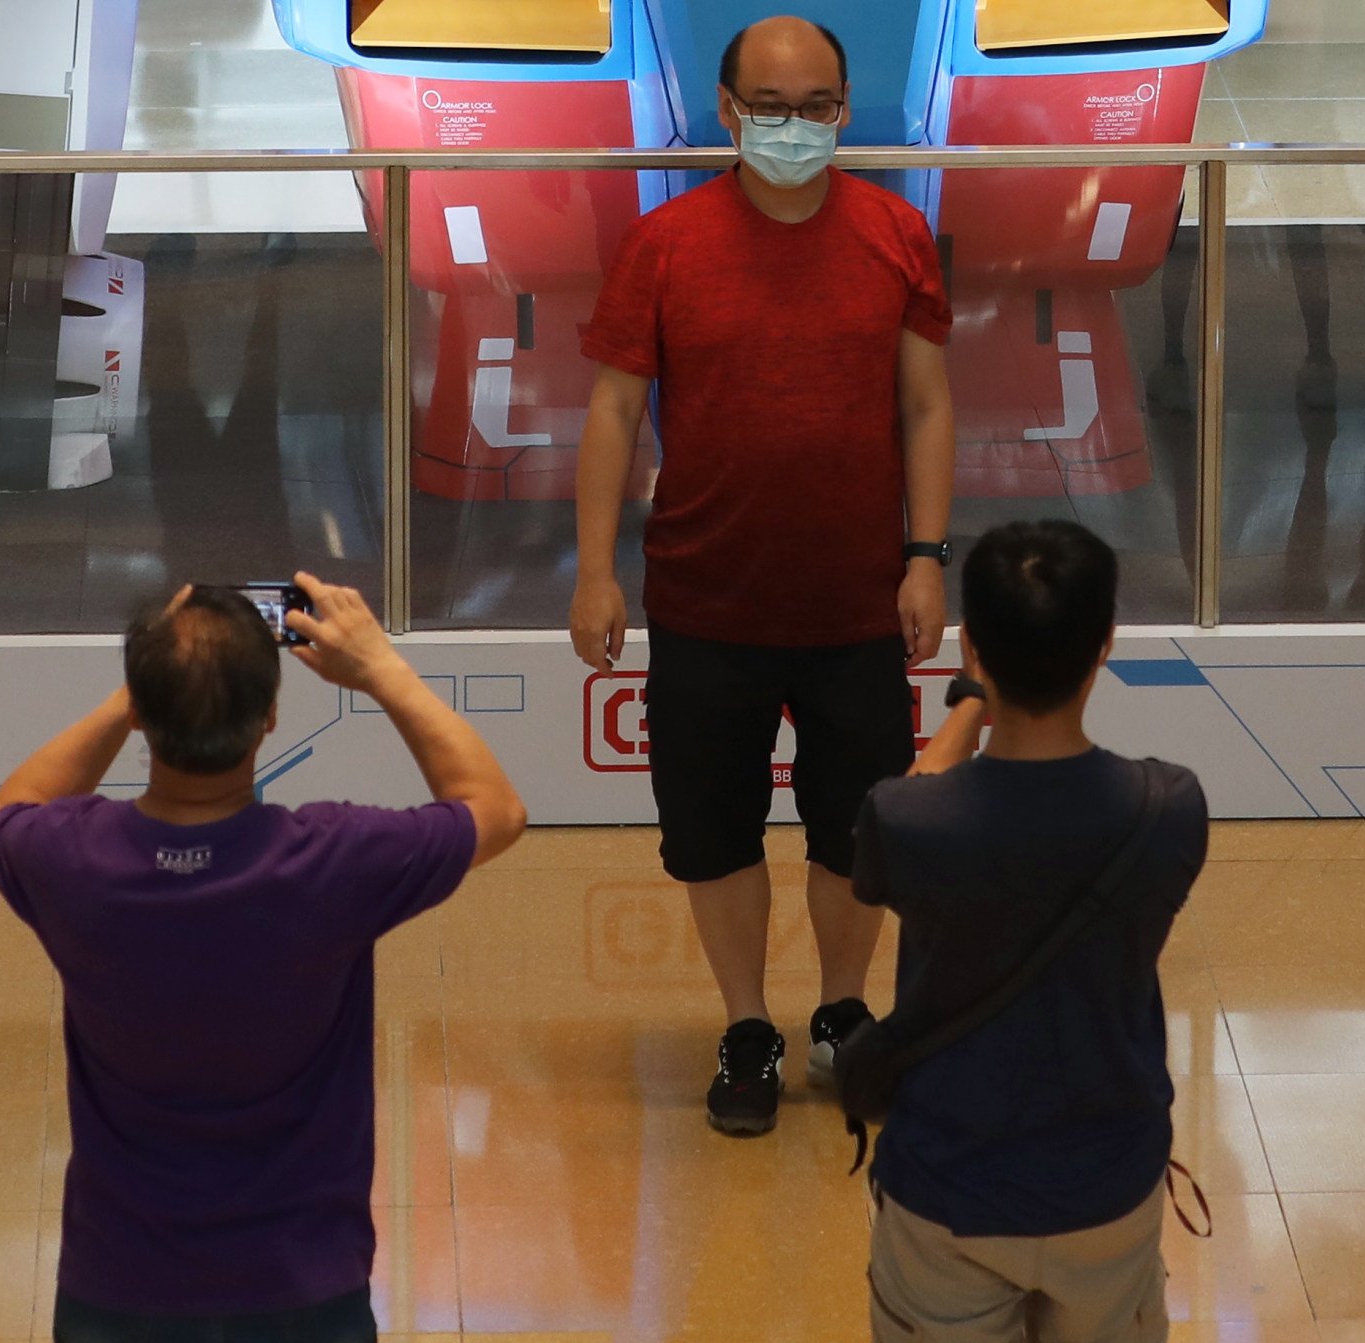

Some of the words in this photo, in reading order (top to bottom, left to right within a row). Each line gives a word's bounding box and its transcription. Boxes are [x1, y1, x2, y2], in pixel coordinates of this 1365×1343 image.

[1086, 96, 1114, 104] ARMOR
[1100, 110, 1134, 119] CAUTION
[442, 116, 478, 124] CAUTION
[773, 769, 792, 783] BB
